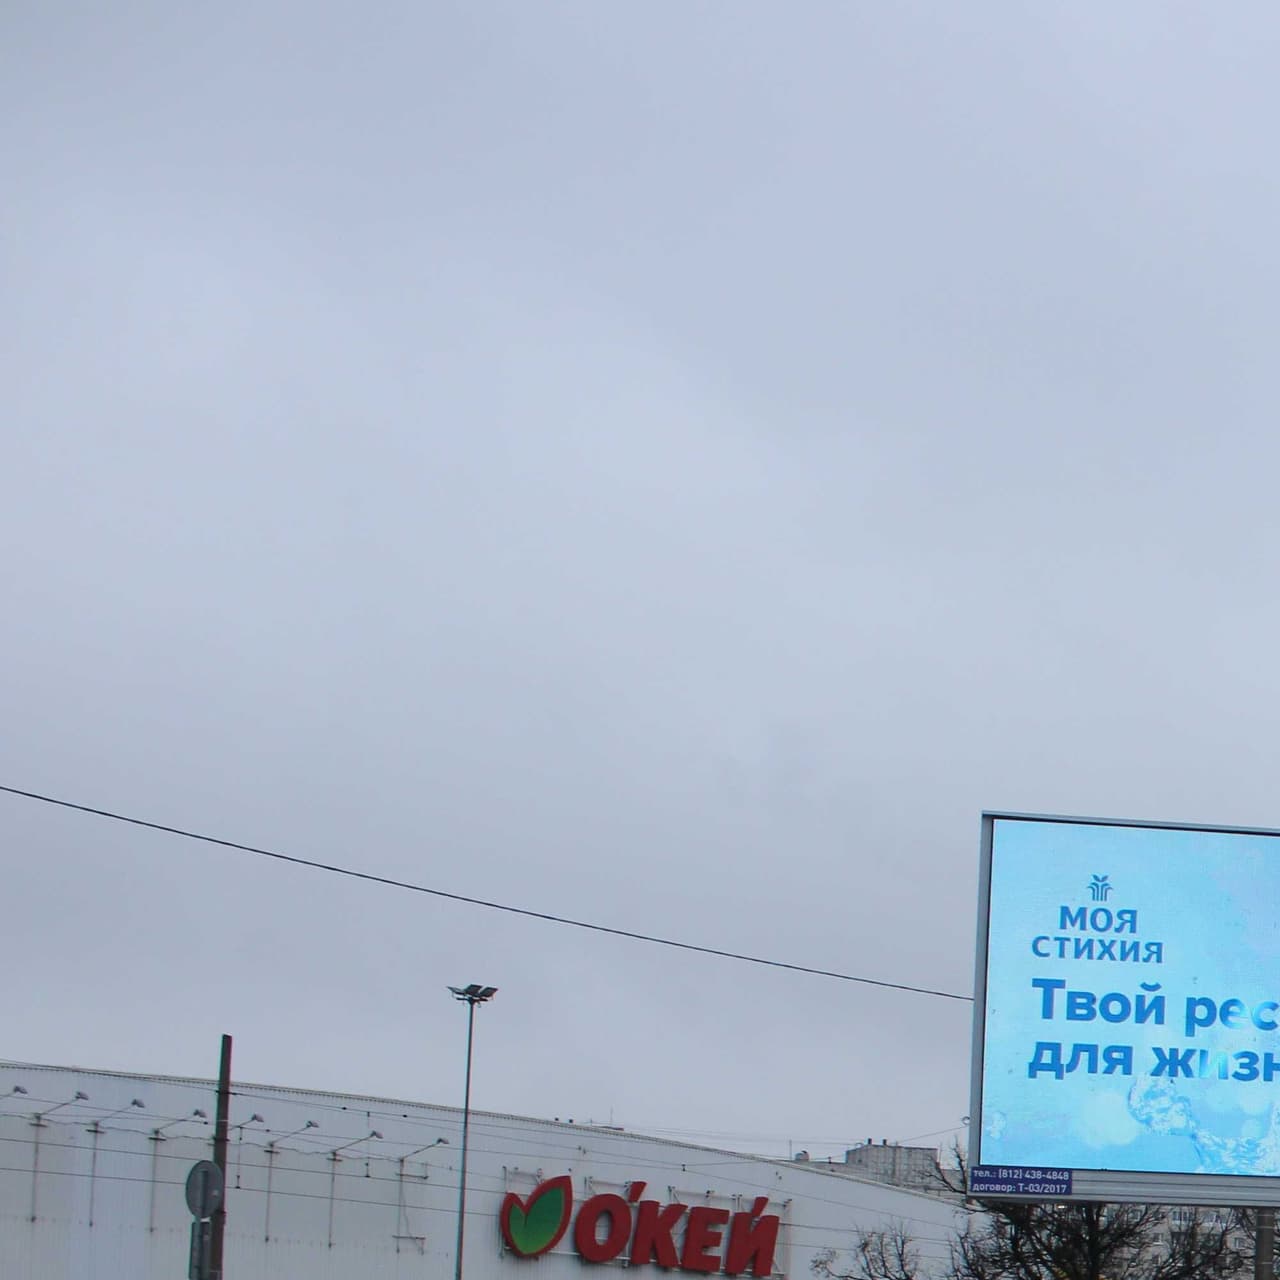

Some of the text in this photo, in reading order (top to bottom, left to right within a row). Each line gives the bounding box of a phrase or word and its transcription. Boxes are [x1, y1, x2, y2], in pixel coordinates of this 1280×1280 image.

[1059, 905, 1138, 934] МОЯ
[1031, 935, 1163, 964] СТИХИЯ
[1031, 978, 1166, 1025] Твой
[1028, 1041, 1133, 1080] для
[972, 1183, 1016, 1192] договор:
[1024, 1169, 1070, 1180] 438-4848
